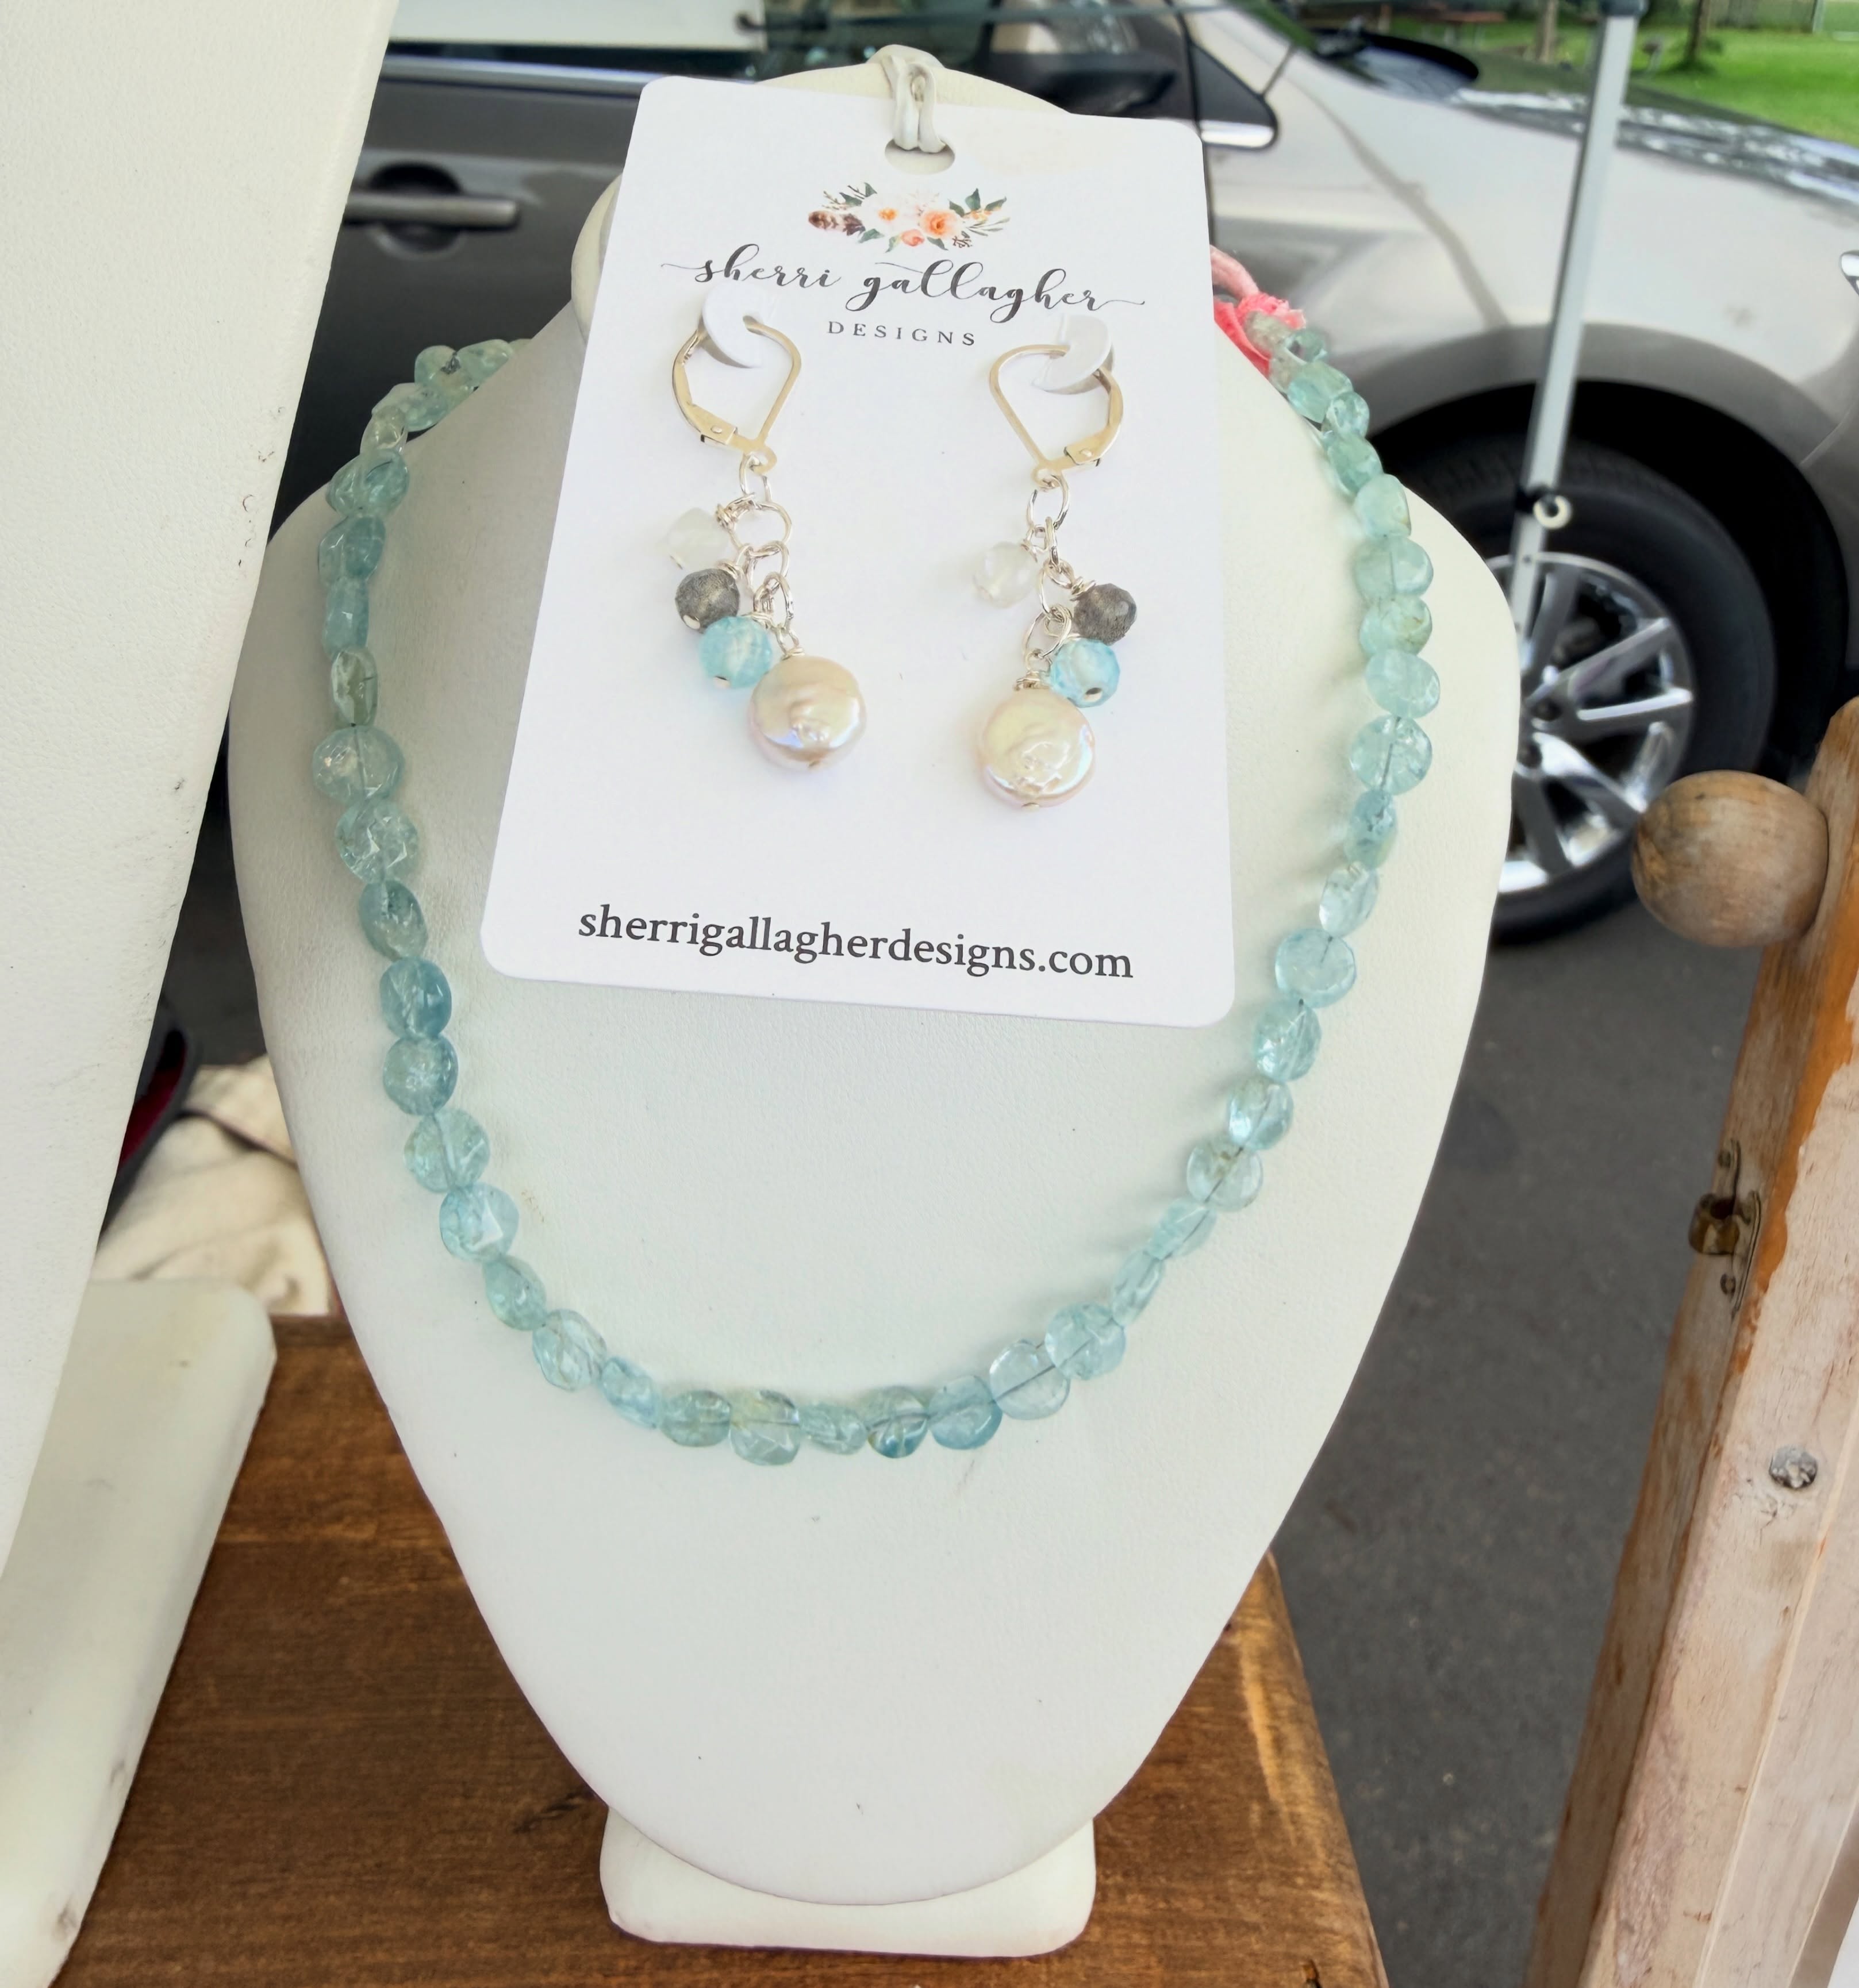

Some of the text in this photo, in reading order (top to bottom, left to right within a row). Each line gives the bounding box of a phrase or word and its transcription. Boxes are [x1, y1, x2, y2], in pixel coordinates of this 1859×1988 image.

[661, 243, 1145, 324] sherri gallagher
[828, 321, 975, 347] DESIGNS
[578, 903, 1134, 979] sherrigallagherdesigns.com
